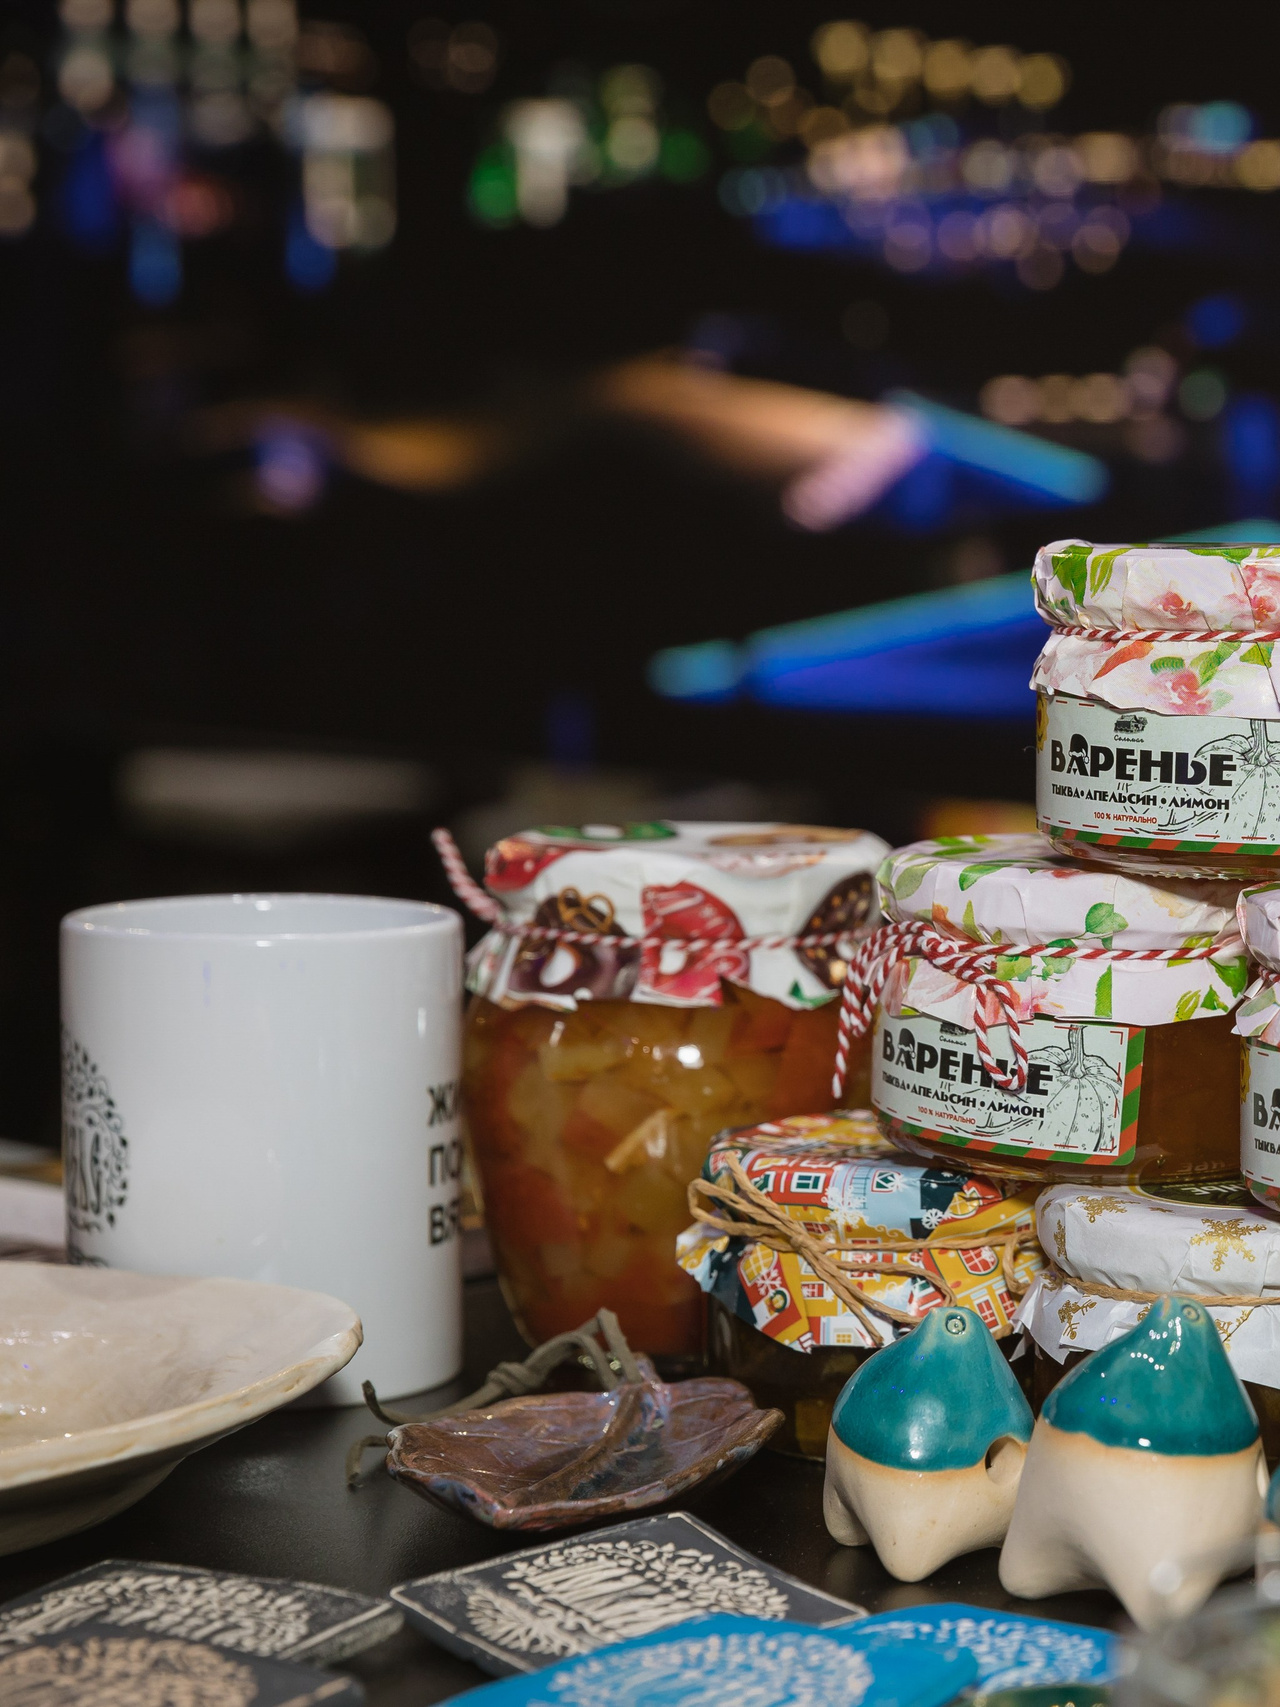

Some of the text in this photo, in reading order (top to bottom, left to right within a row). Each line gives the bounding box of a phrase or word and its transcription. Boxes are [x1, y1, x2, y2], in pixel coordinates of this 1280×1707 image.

[1051, 734, 1237, 787] ВАРЕНЬЕ
[1051, 783, 1230, 811] ТЫКВА АПЕЛЬСИН ЛИМОН
[1113, 814, 1158, 824] НАТУРАЛЬНО
[911, 1083, 977, 1108] АПЕЛЬСИН
[987, 1100, 1045, 1118] ЛИМОН
[935, 1111, 976, 1125] НАТУРАЛЬНО
